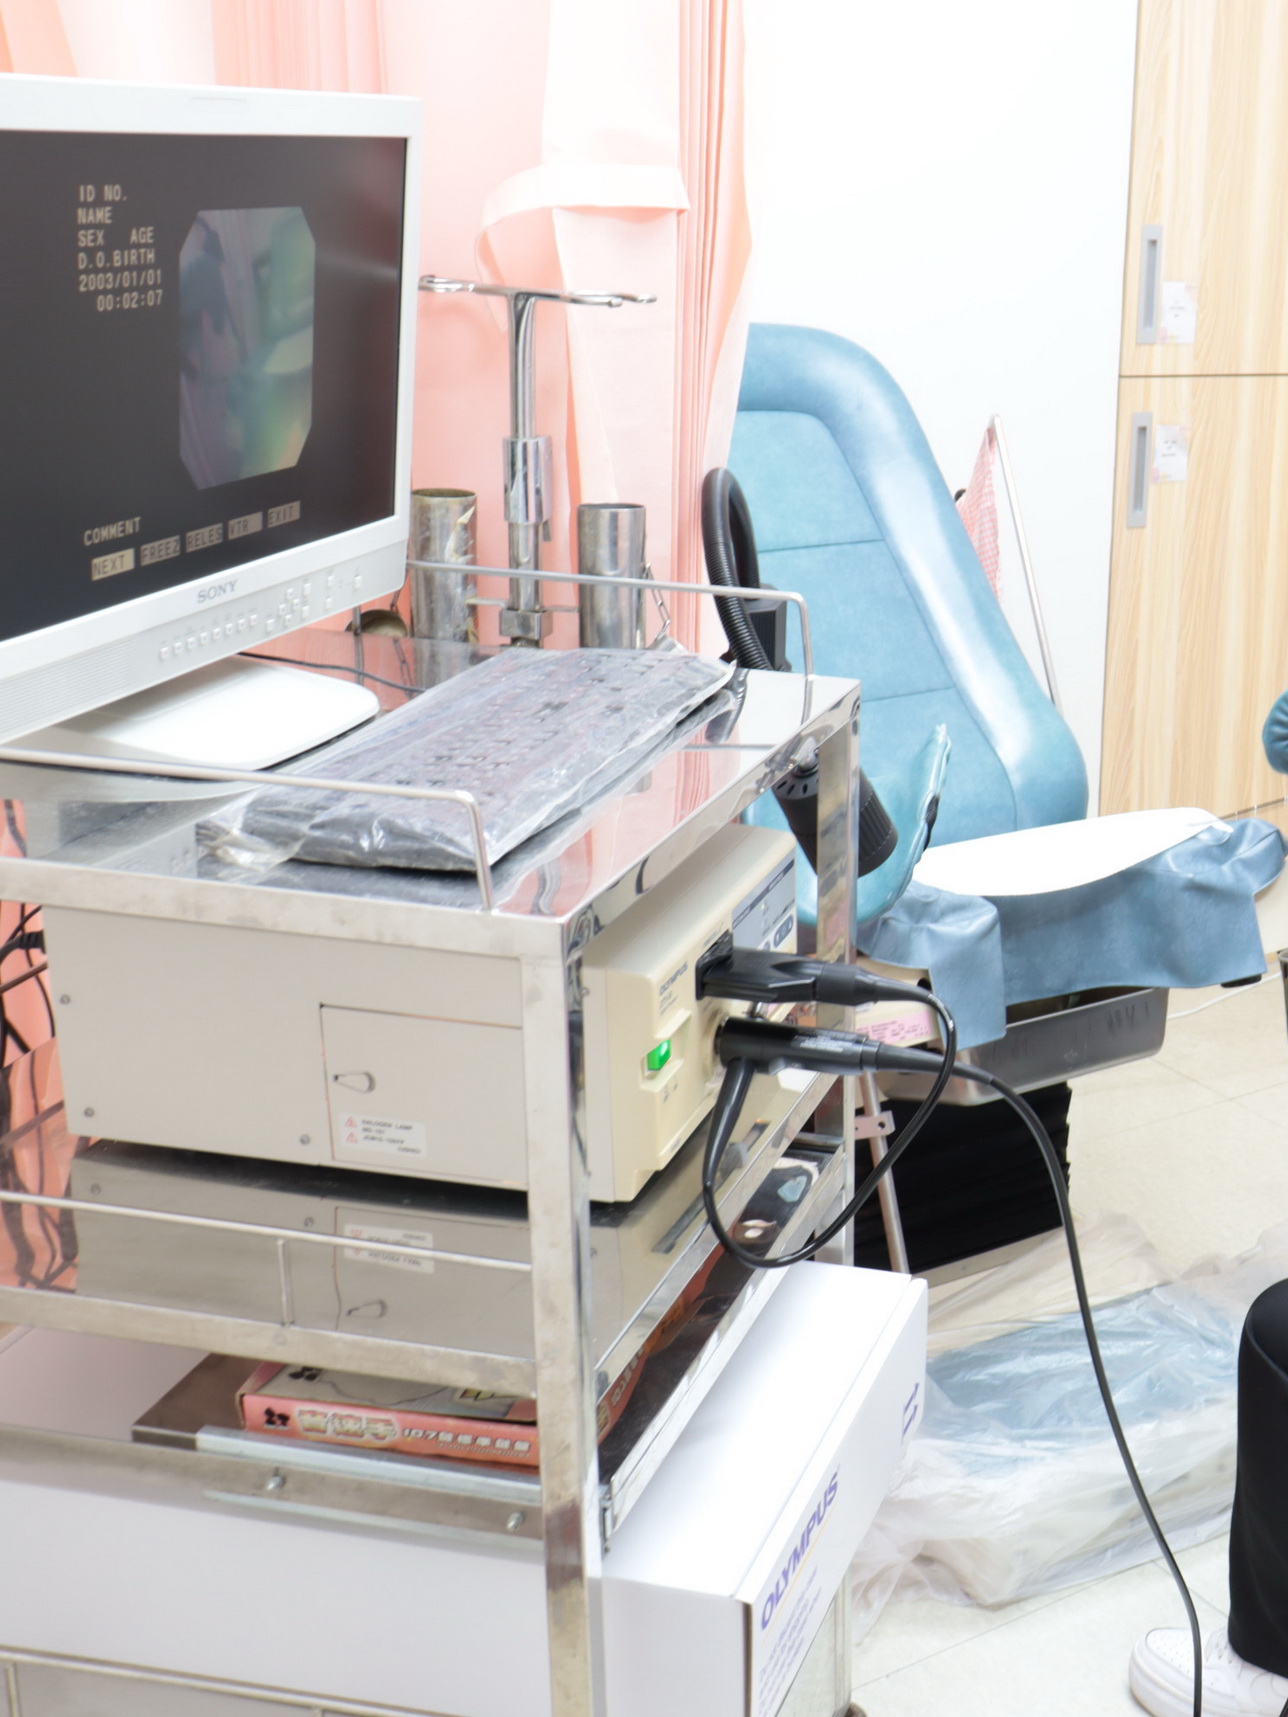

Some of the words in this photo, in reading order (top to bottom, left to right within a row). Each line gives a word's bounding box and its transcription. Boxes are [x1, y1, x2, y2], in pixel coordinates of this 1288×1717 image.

[80, 184, 95, 202] ID
[104, 184, 127, 202] NO.
[77, 206, 112, 224] NAME
[78, 229, 104, 247] SEX
[130, 226, 154, 244] AGE
[78, 248, 155, 269] D.O.BIRTH
[79, 269, 162, 292] 2003/01/01
[97, 289, 163, 312] 00:02:07
[84, 516, 142, 546] COMMENT
[92, 554, 125, 577] NEXT
[141, 539, 181, 564] FREEZ
[186, 524, 223, 549] RELES
[228, 517, 250, 538] VTR
[267, 504, 294, 525] EXIT
[197, 580, 238, 603] SONY
[761, 1469, 839, 1630] OLYMPUS
